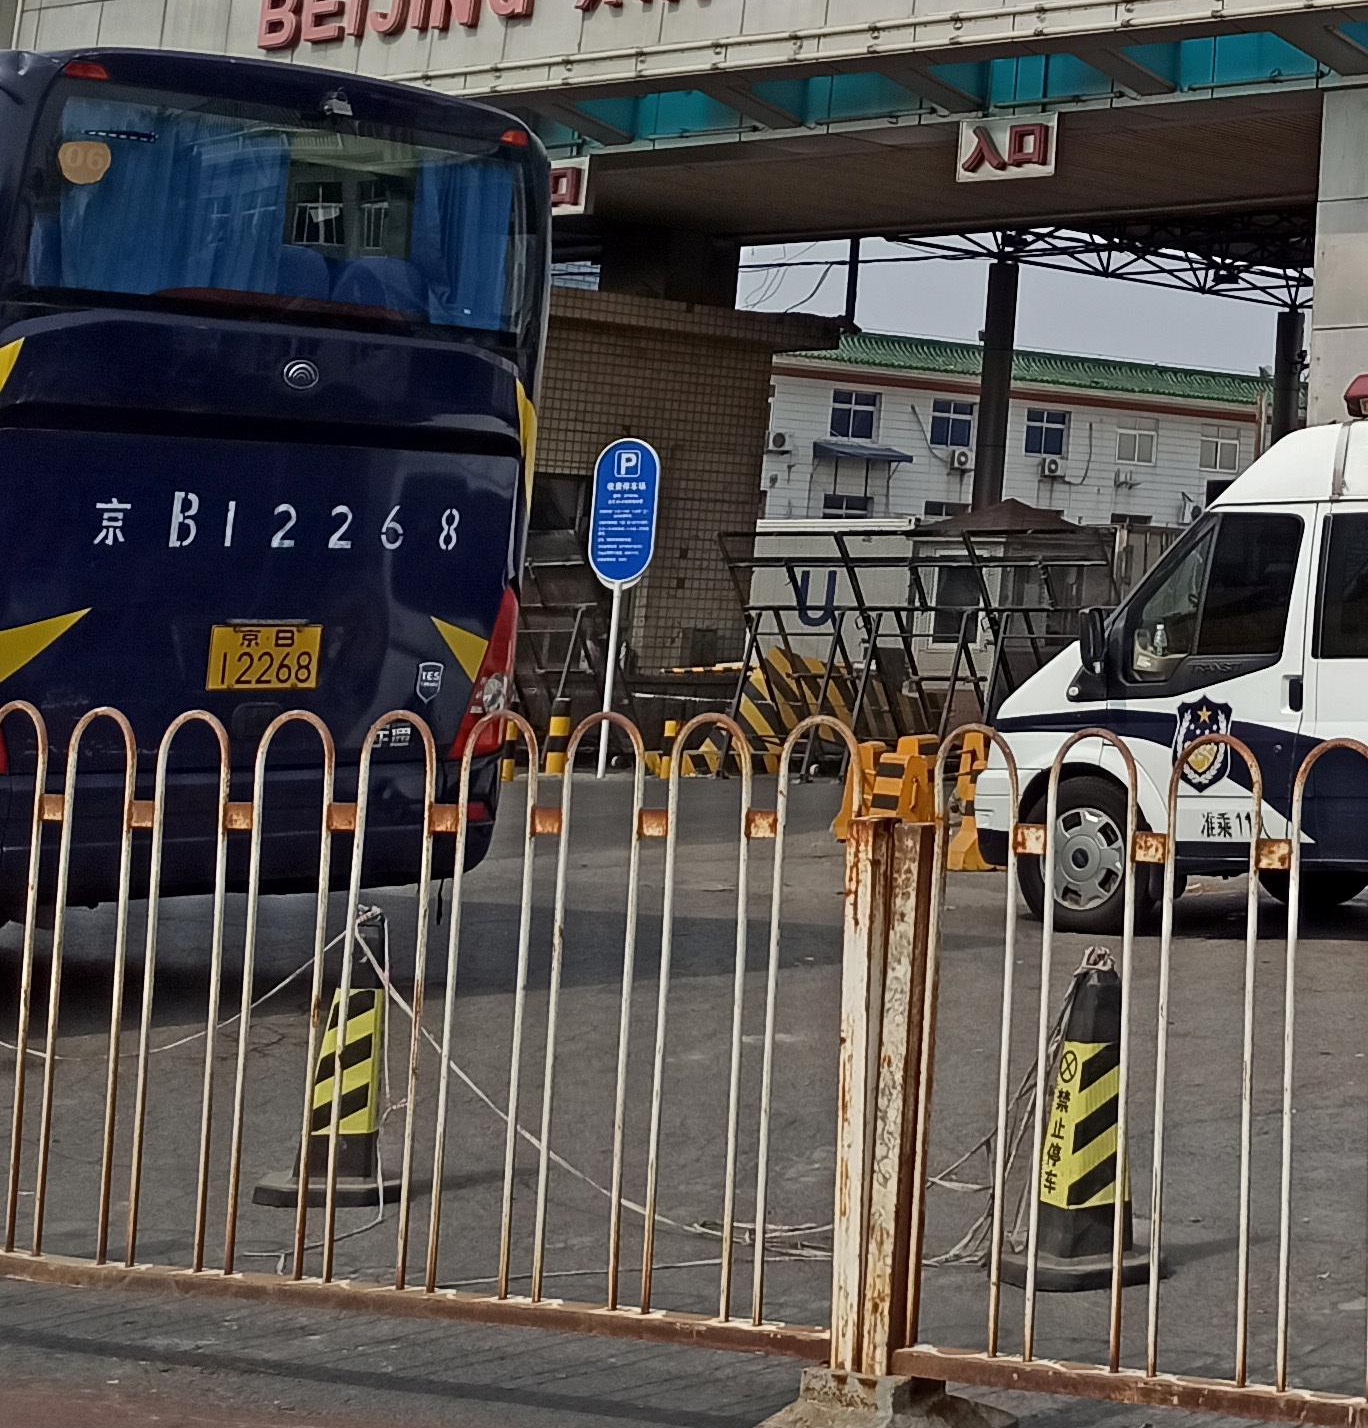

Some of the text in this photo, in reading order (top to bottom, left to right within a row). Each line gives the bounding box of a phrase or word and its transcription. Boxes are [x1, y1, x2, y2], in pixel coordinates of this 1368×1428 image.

[962, 123, 1049, 172] 入口
[620, 453, 637, 475] P
[221, 651, 312, 684] 12268
[1043, 1088, 1071, 1194] 禁止停车
